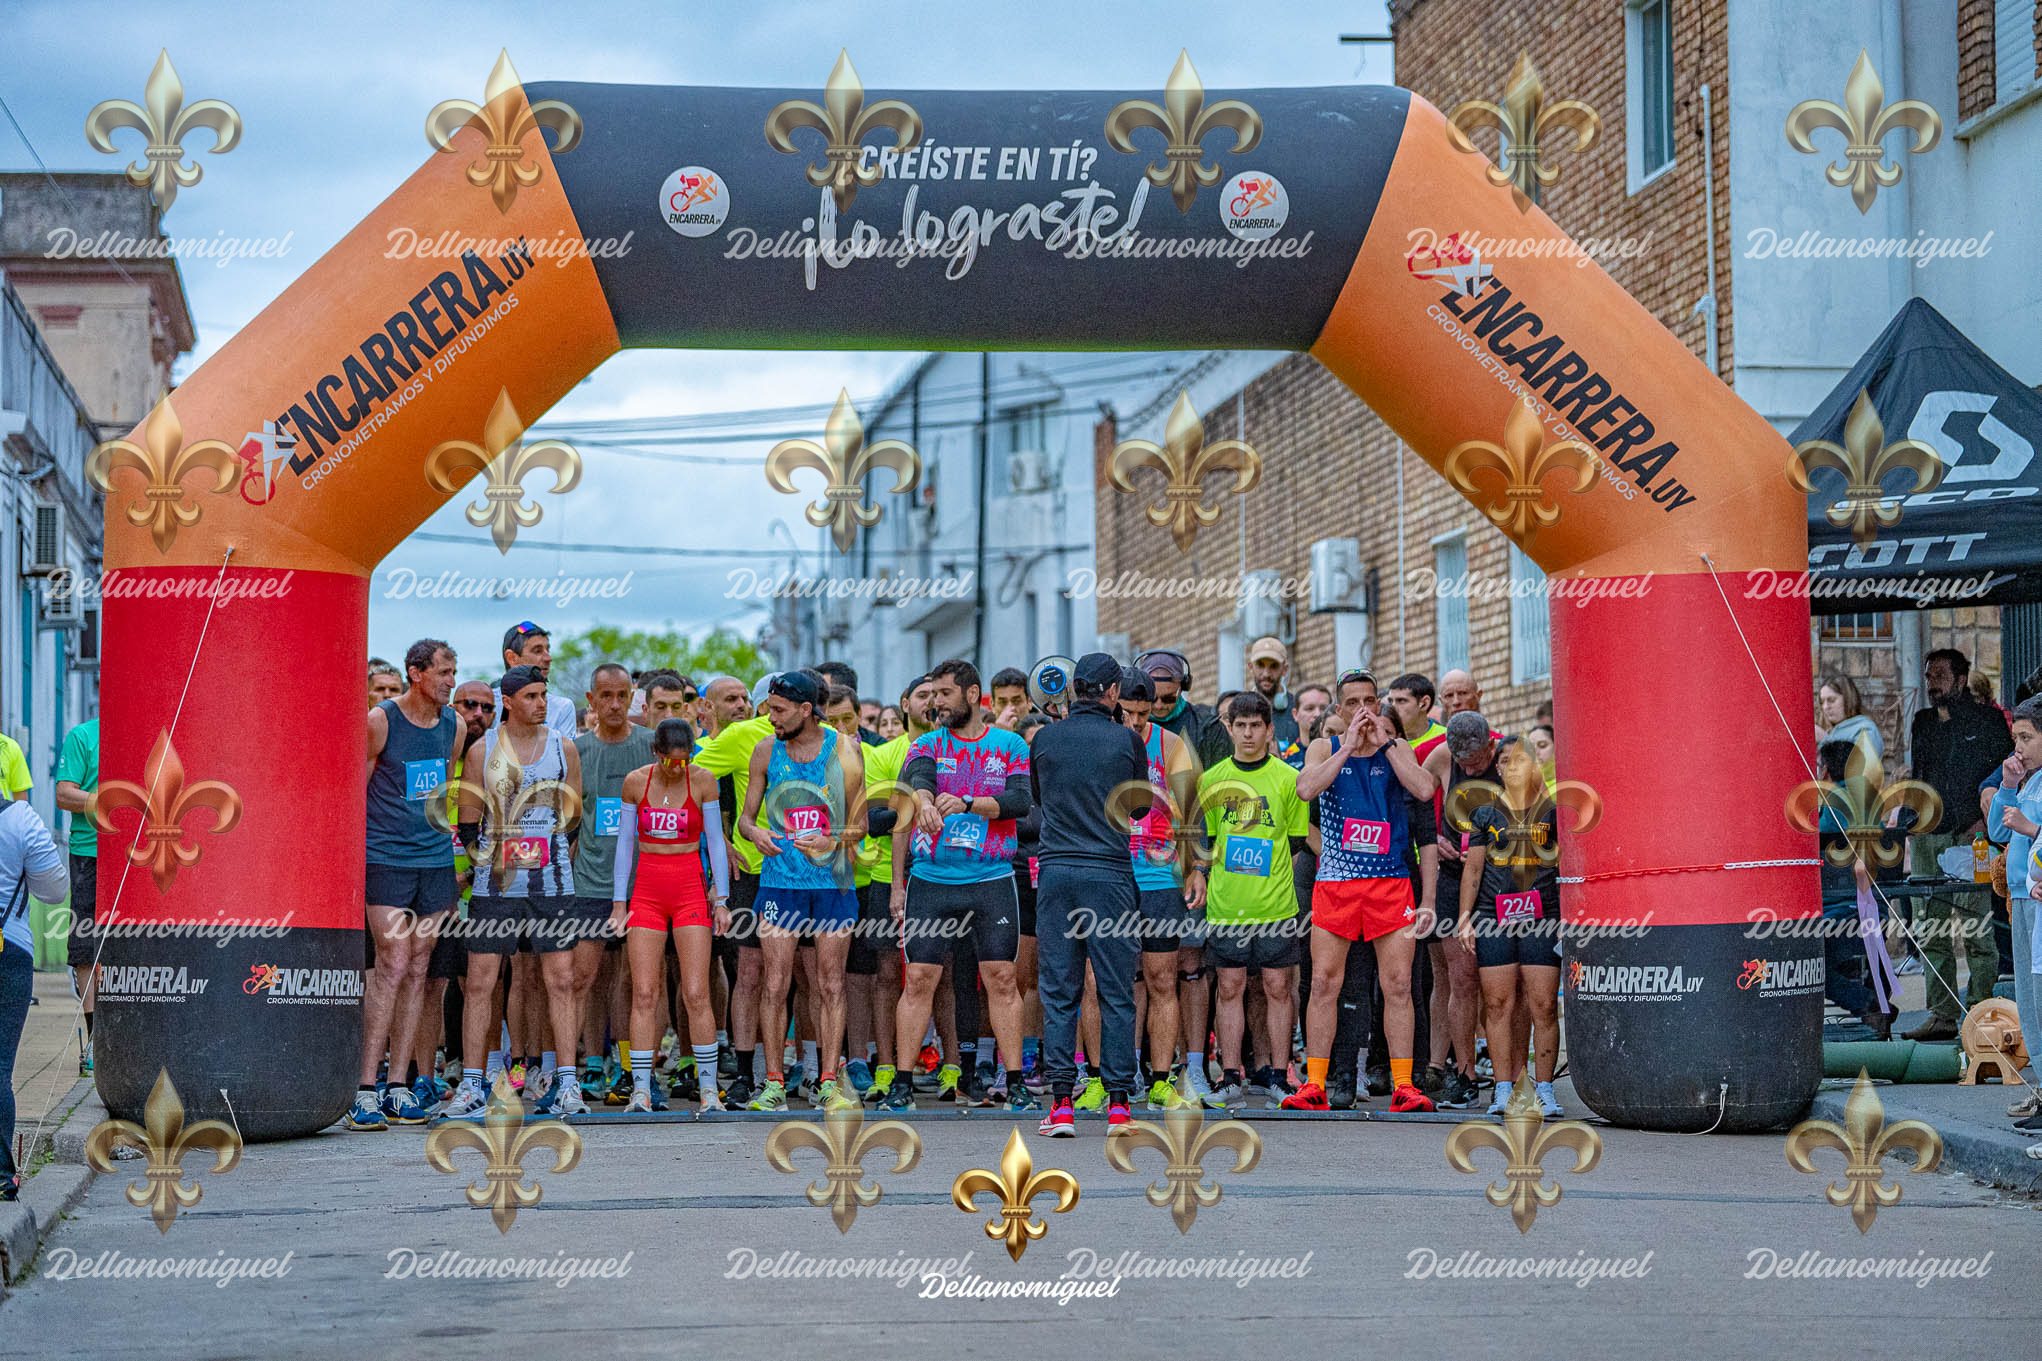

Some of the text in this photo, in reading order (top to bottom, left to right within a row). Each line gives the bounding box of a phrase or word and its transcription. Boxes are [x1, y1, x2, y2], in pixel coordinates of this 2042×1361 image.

[997, 147, 1040, 180] EN
[1049, 139, 1098, 181] TÍ?
[902, 177, 1151, 281] lograste!
[301, 292, 520, 491] CRONOMETRAMOS Y DIFUNDIMOS
[1425, 303, 1638, 501] CRONOMETRAMOS Y DIFUNDIMOS
[1807, 532, 1988, 573] COTT
[415, 771, 439, 790] 413
[603, 809, 621, 826] 37
[650, 811, 678, 830] 178
[792, 809, 820, 829] 179
[949, 820, 981, 840] 425
[1350, 823, 1382, 844] 207
[509, 841, 542, 860] 234
[1231, 847, 1263, 867] 406
[1503, 895, 1535, 916] 224
[140, 995, 187, 1003] DIFUNDIMOS
[266, 997, 329, 1006] CRONOMETRAMOS
[1577, 993, 1683, 1002] CRONOMETRAMOS Y DIFUNDIMOS
